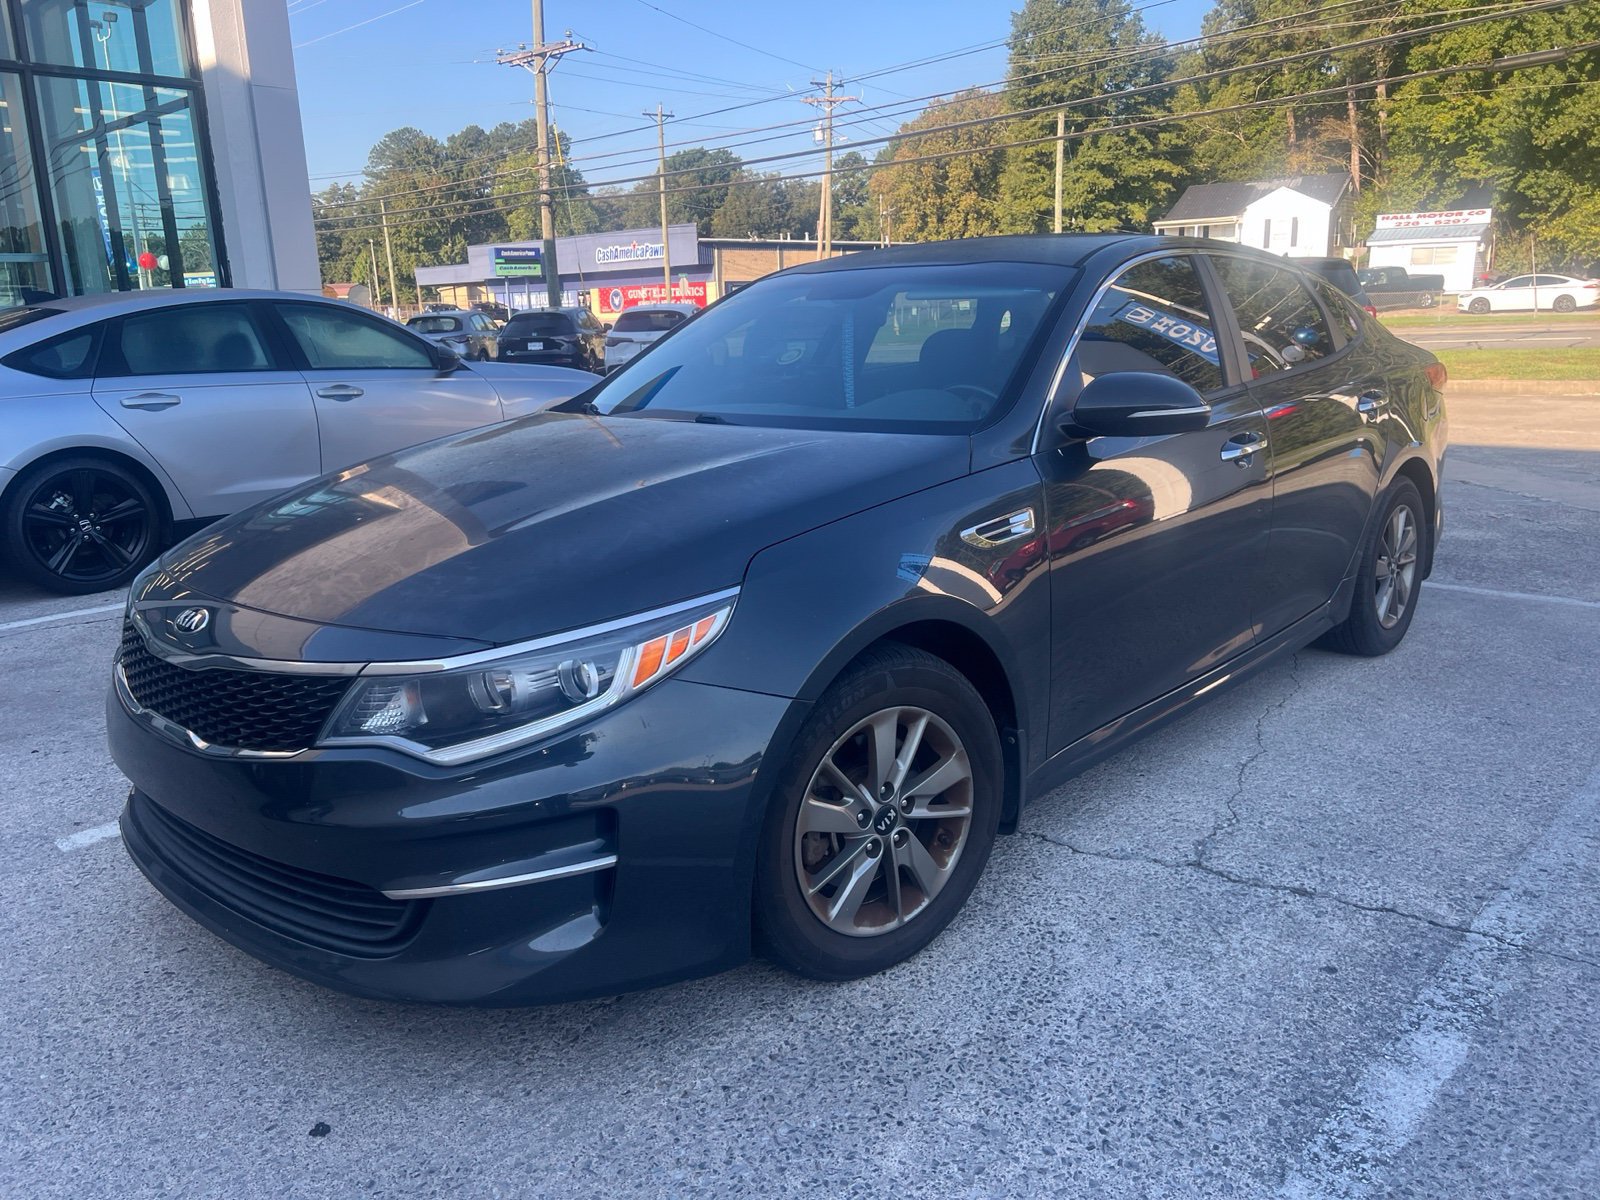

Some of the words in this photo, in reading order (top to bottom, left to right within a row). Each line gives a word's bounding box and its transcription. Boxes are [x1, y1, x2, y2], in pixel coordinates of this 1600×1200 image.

[1417, 211, 1463, 219] MOTOR
[628, 288, 648, 299] GUNS
[653, 285, 704, 299] ELETRNICS
[177, 609, 202, 630] KIA
[877, 808, 897, 831] KIA
